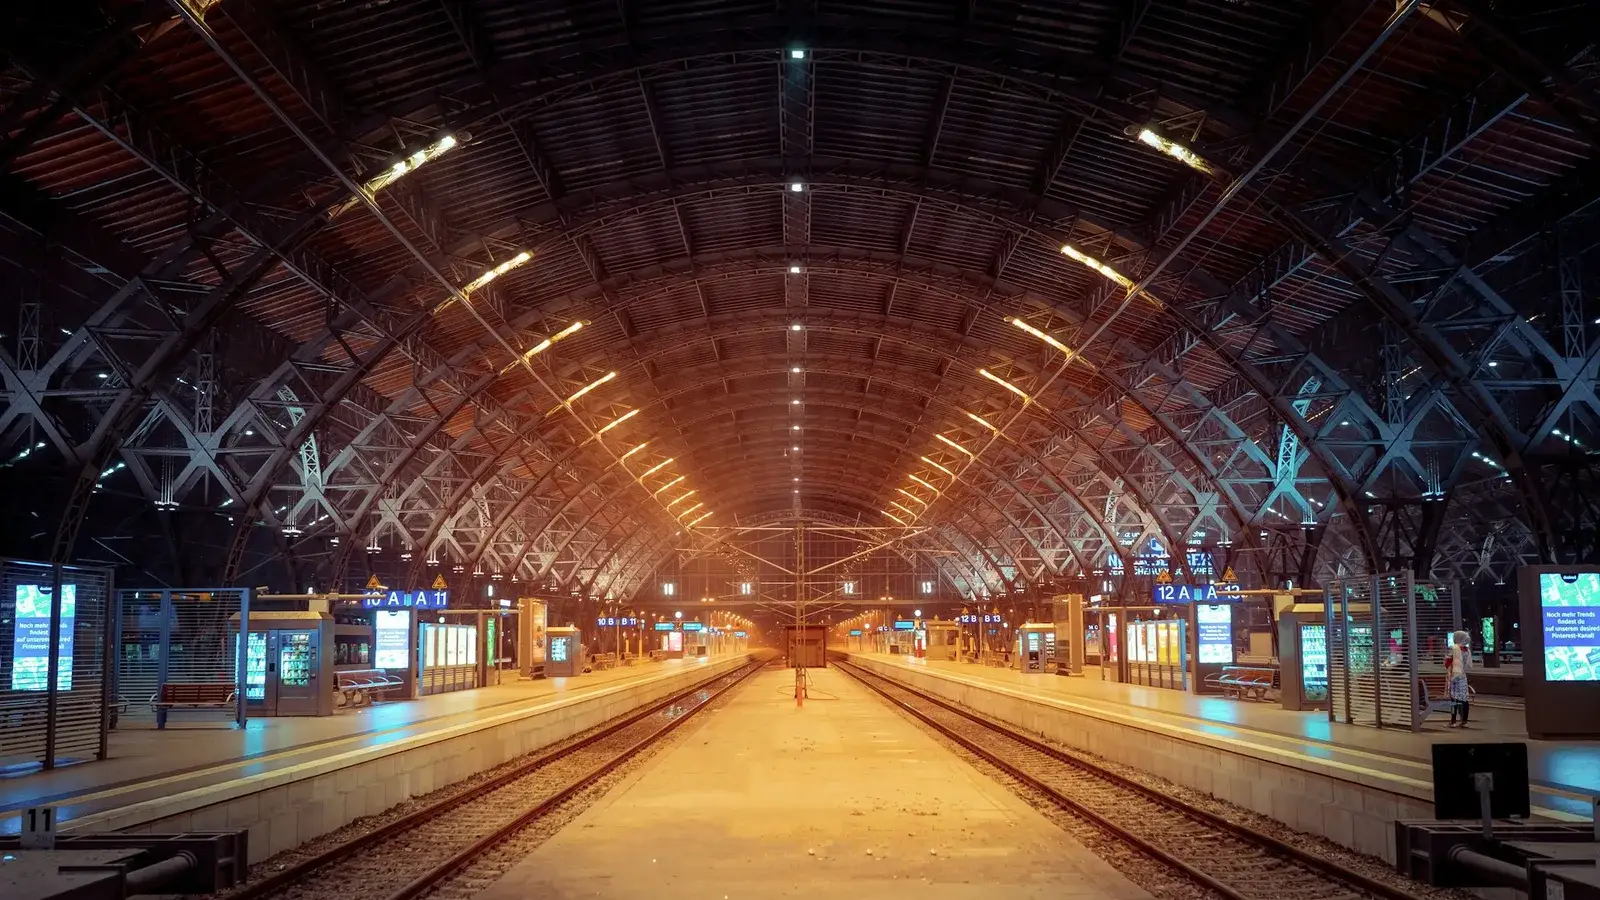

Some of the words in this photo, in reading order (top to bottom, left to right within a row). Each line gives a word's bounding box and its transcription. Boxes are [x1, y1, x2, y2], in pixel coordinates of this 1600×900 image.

[844, 582, 854, 594] 12
[922, 581, 932, 593] 13
[1158, 586, 1174, 600] 12
[1179, 585, 1190, 600] A
[1206, 586, 1217, 600] A
[1225, 585, 1240, 599] 13
[366, 591, 381, 605] 10
[388, 591, 399, 605] A
[416, 591, 427, 605] A
[434, 591, 447, 605] 11
[598, 617, 606, 626] 10
[608, 617, 614, 626] B
[621, 617, 628, 626] B
[630, 617, 637, 626] 11
[961, 614, 969, 623] 12
[971, 614, 977, 623] B
[984, 614, 991, 623] B
[993, 614, 1001, 623] 13
[28, 808, 51, 832] 11
